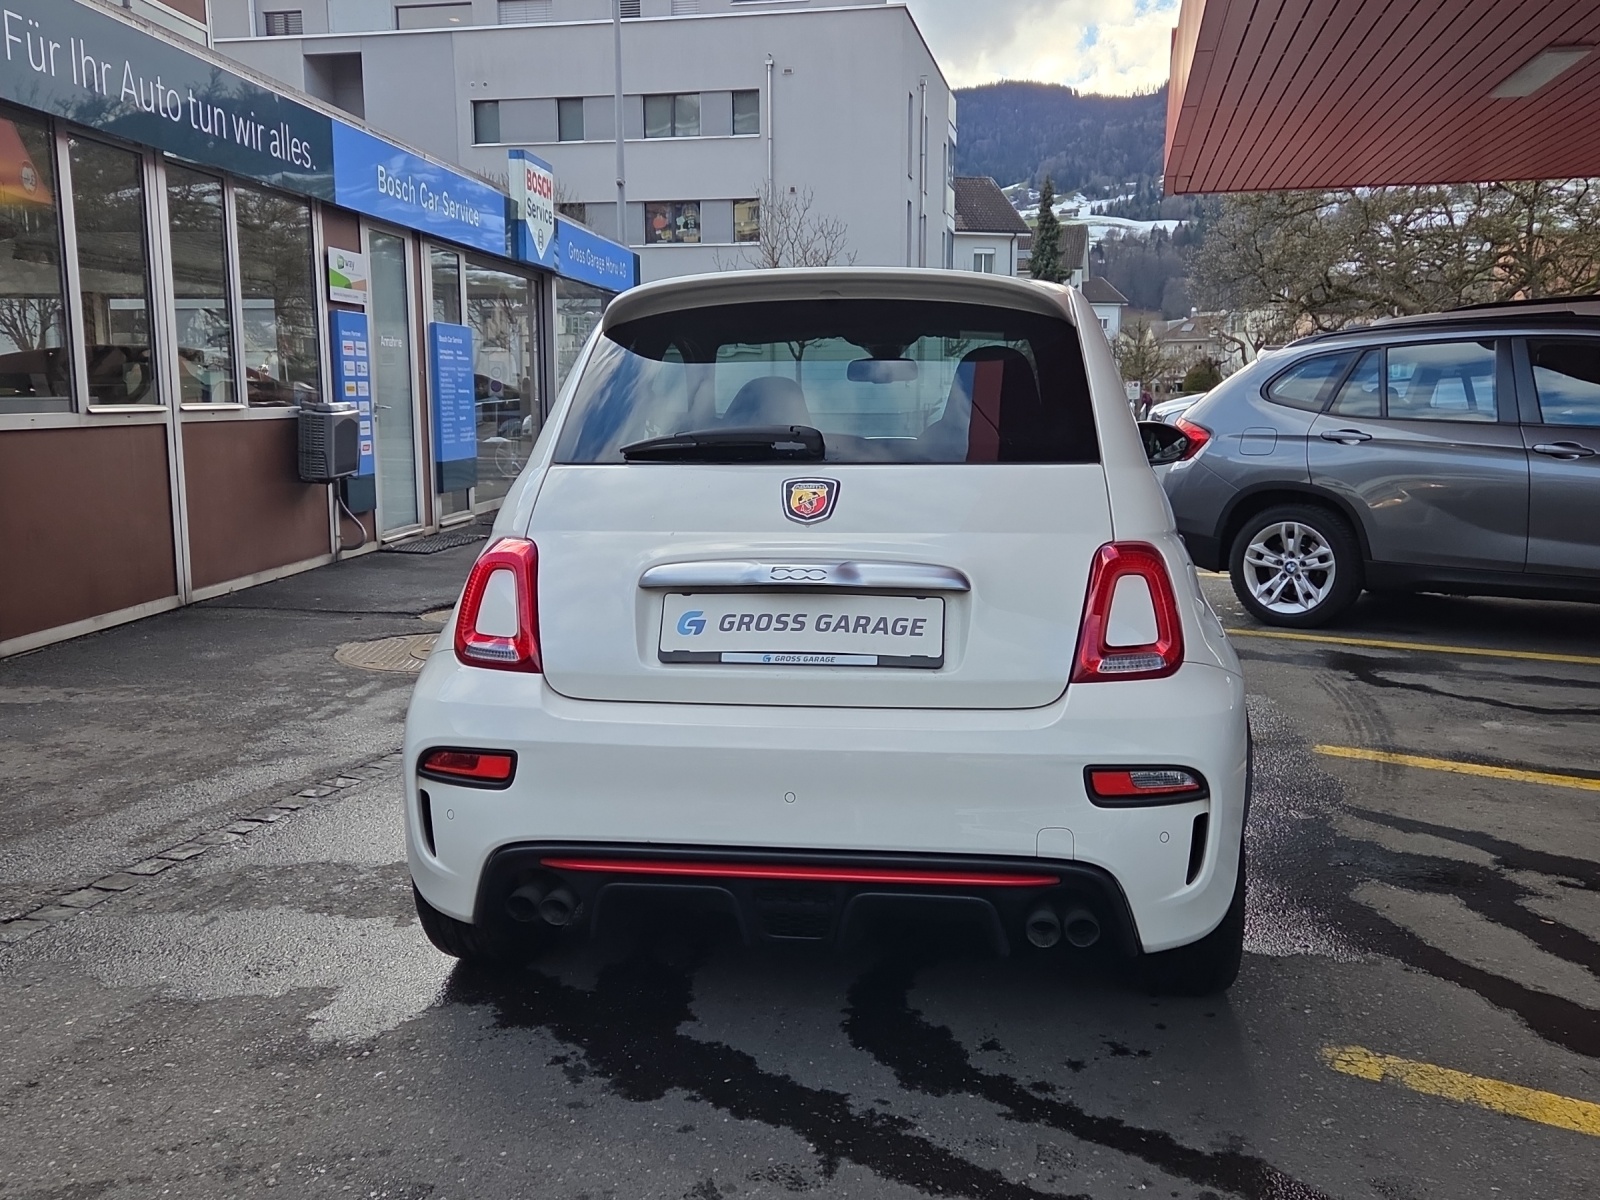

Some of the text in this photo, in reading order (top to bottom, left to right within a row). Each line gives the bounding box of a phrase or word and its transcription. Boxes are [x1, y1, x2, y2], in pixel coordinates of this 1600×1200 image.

[3, 9, 317, 171] Für Ihr Auto tun wir alles.
[377, 164, 479, 227] Bosch Car Service
[526, 168, 552, 201] BOSCH
[526, 197, 553, 226] Service
[568, 241, 585, 265] Gross
[586, 248, 605, 275] Garage
[770, 566, 828, 581] 500
[718, 613, 808, 633] GROSS
[814, 613, 927, 637] GARAGE
